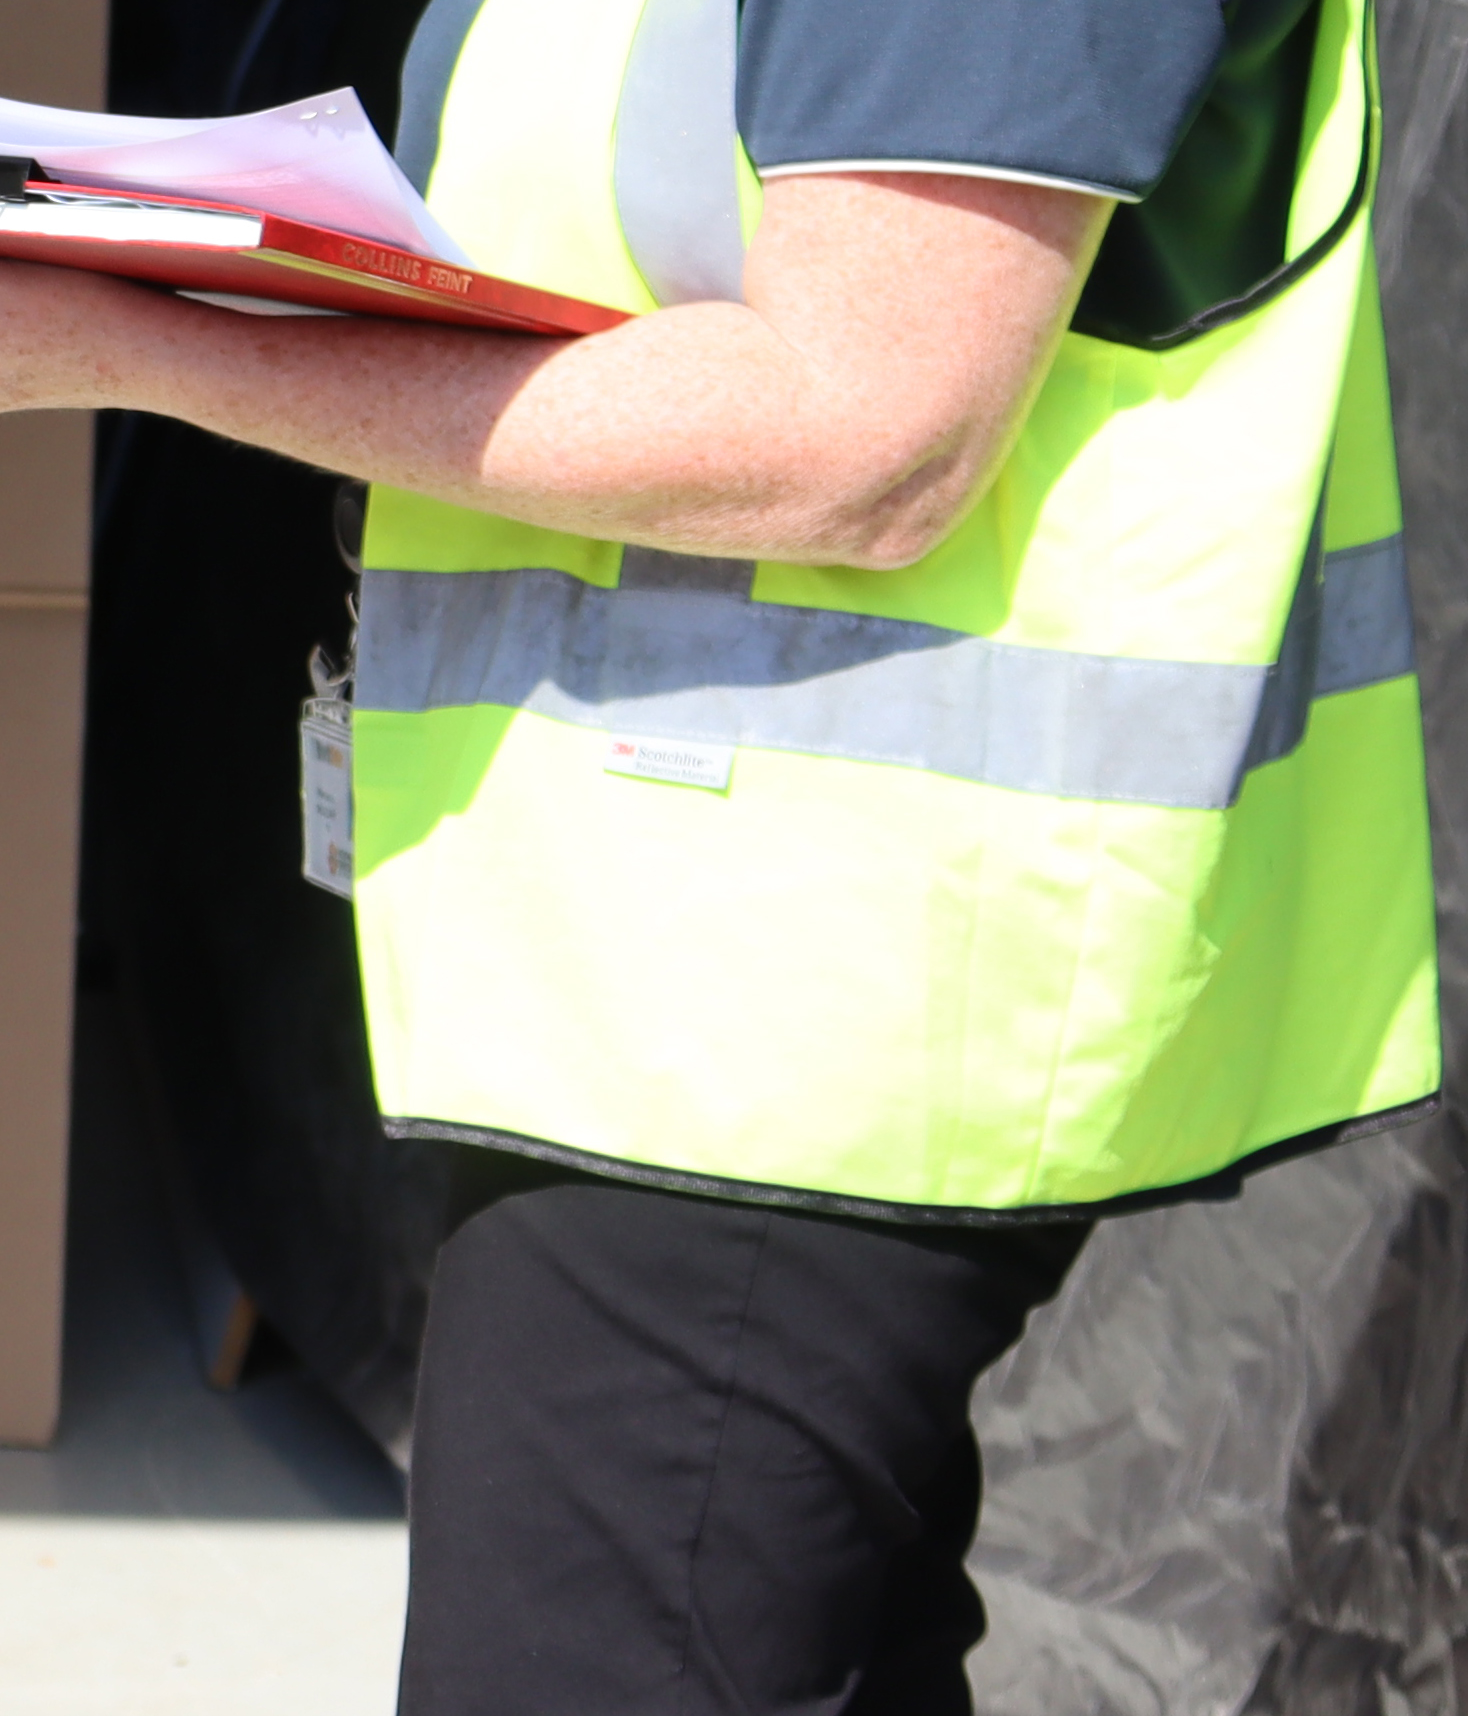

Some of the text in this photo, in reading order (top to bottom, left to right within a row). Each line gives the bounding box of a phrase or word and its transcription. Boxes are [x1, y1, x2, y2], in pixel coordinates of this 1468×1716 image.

[341, 242, 474, 294] COLLINS FEINT
[612, 742, 635, 757] 3M
